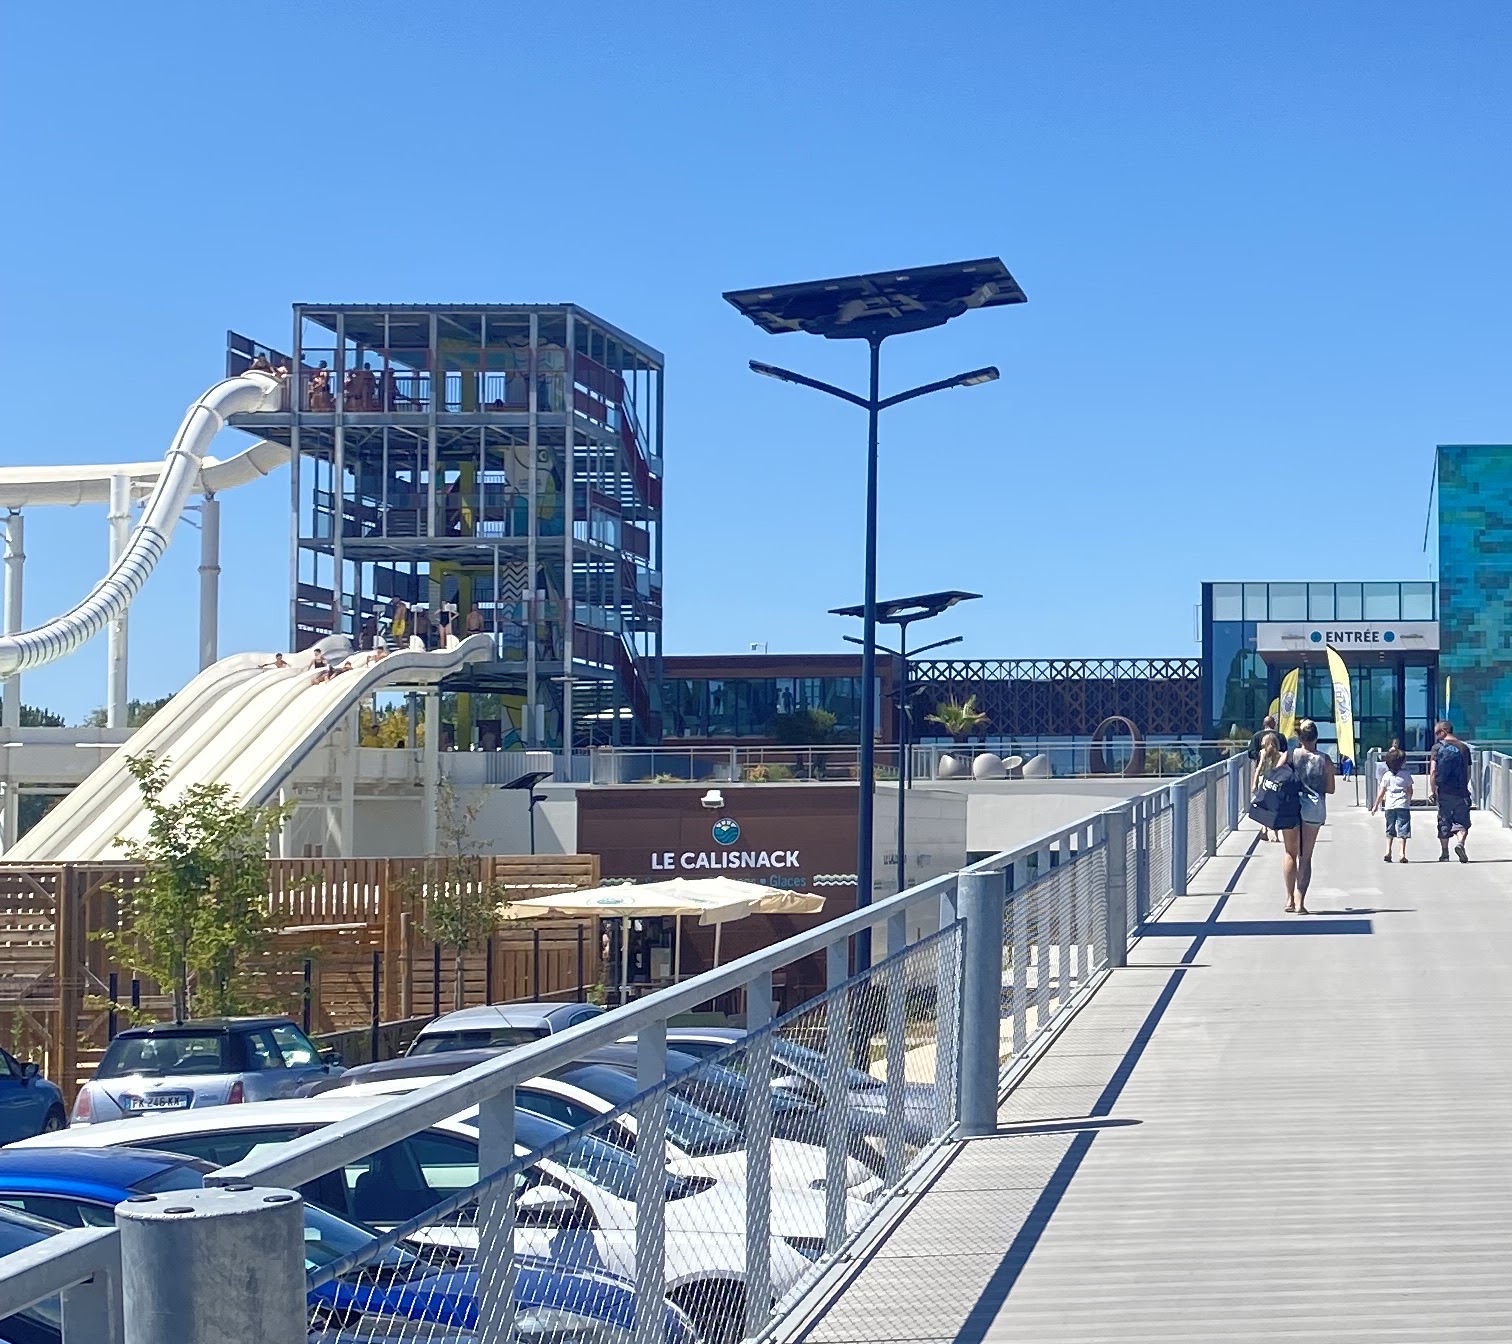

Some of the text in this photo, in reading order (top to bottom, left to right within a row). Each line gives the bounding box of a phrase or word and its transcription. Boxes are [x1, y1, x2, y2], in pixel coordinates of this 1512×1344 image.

[1326, 628, 1379, 642] ENTRÉE
[652, 850, 800, 870] LE CALISNACK
[769, 874, 807, 887] Glaces
